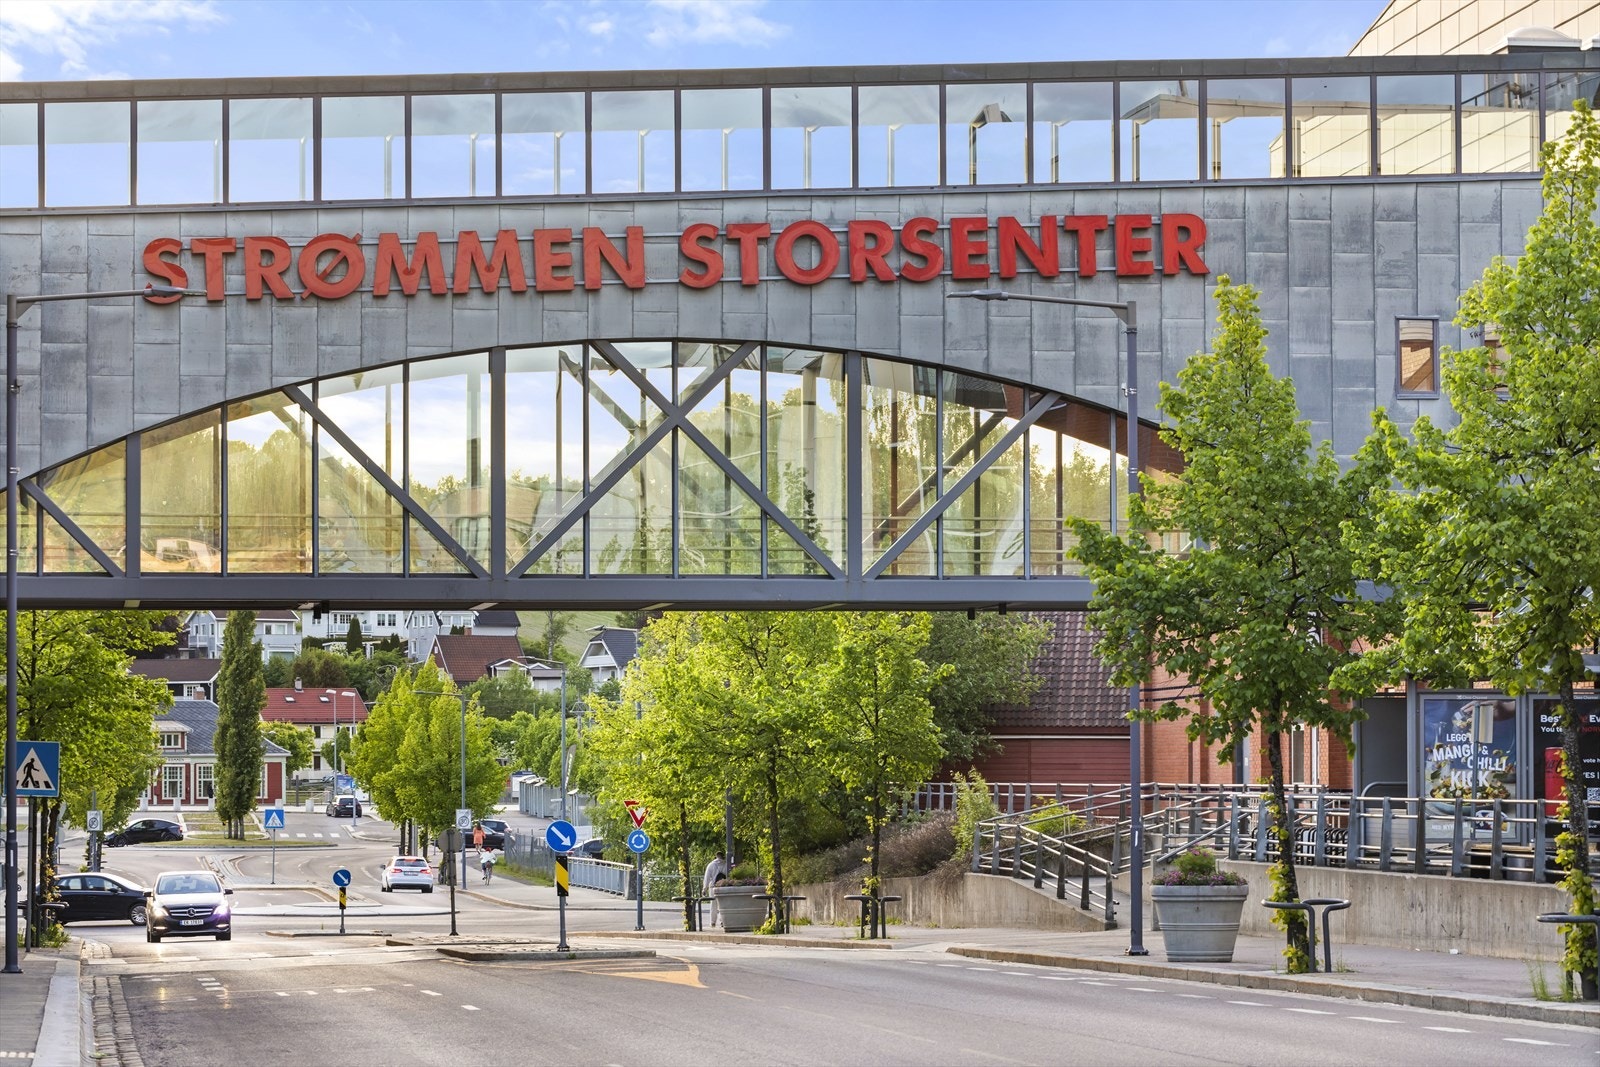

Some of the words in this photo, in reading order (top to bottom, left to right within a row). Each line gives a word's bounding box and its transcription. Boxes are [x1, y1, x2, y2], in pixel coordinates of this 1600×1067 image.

[143, 226, 646, 304] STRØMMEN
[678, 213, 1210, 288] STORSENTER
[1446, 733, 1467, 742] LEGG
[1481, 745, 1489, 755] &
